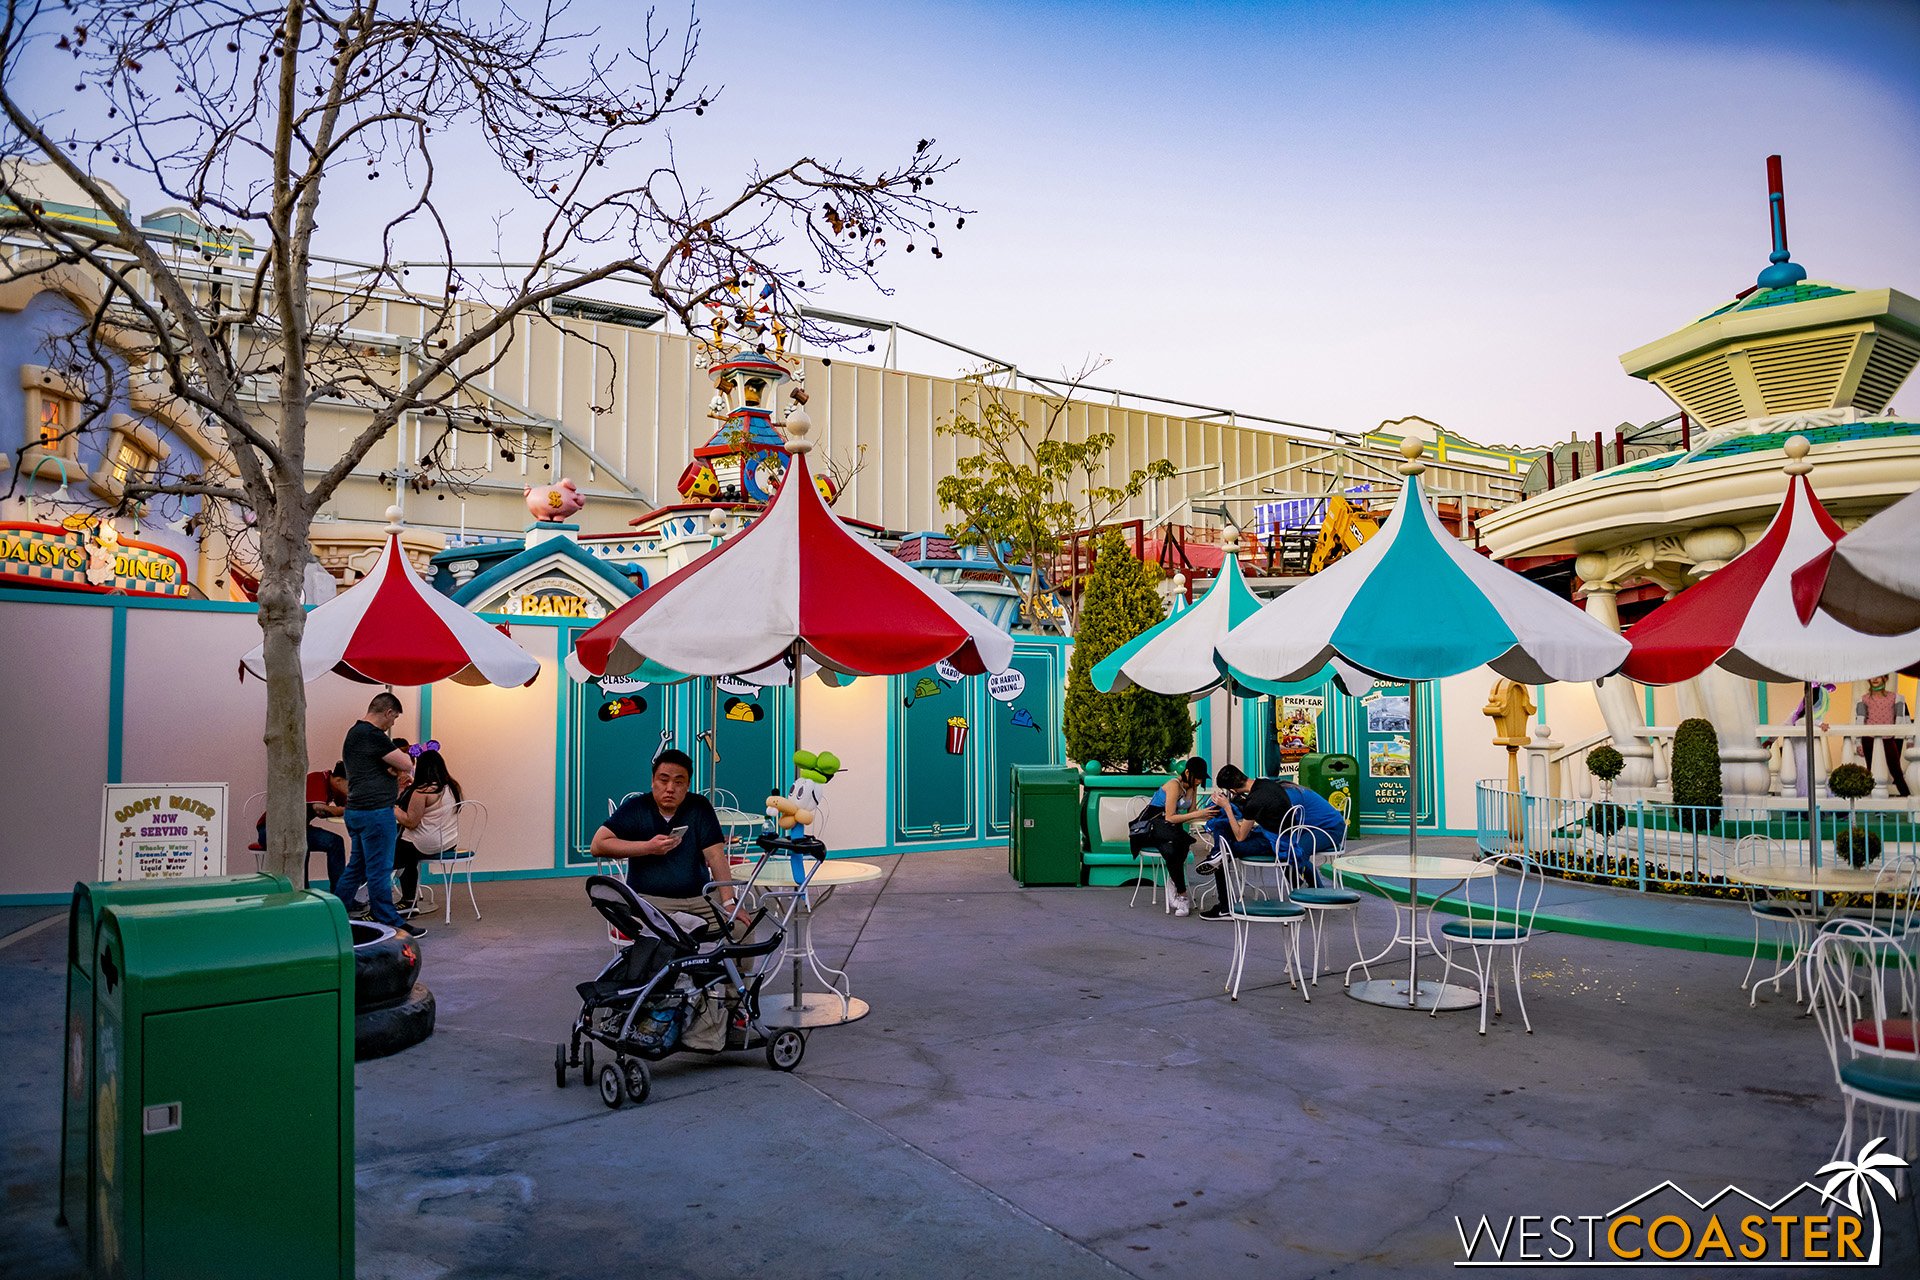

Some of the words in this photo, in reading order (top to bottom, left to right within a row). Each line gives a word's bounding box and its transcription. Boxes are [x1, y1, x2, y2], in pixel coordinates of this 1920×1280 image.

[1349, 522, 1365, 545] JCB
[0, 538, 83, 568] DAISY'S
[115, 556, 175, 582] DINER
[521, 594, 588, 618] BANK
[941, 667, 960, 679] HARD!
[991, 678, 998, 686] OR
[999, 674, 1020, 684] HARDLY
[1373, 680, 1392, 688] OON
[1375, 789, 1407, 797] REEL-Y
[114, 796, 162, 823] GOOFY
[169, 795, 216, 821] WATER
[152, 814, 178, 824] NOW
[140, 826, 188, 837] SERVING
